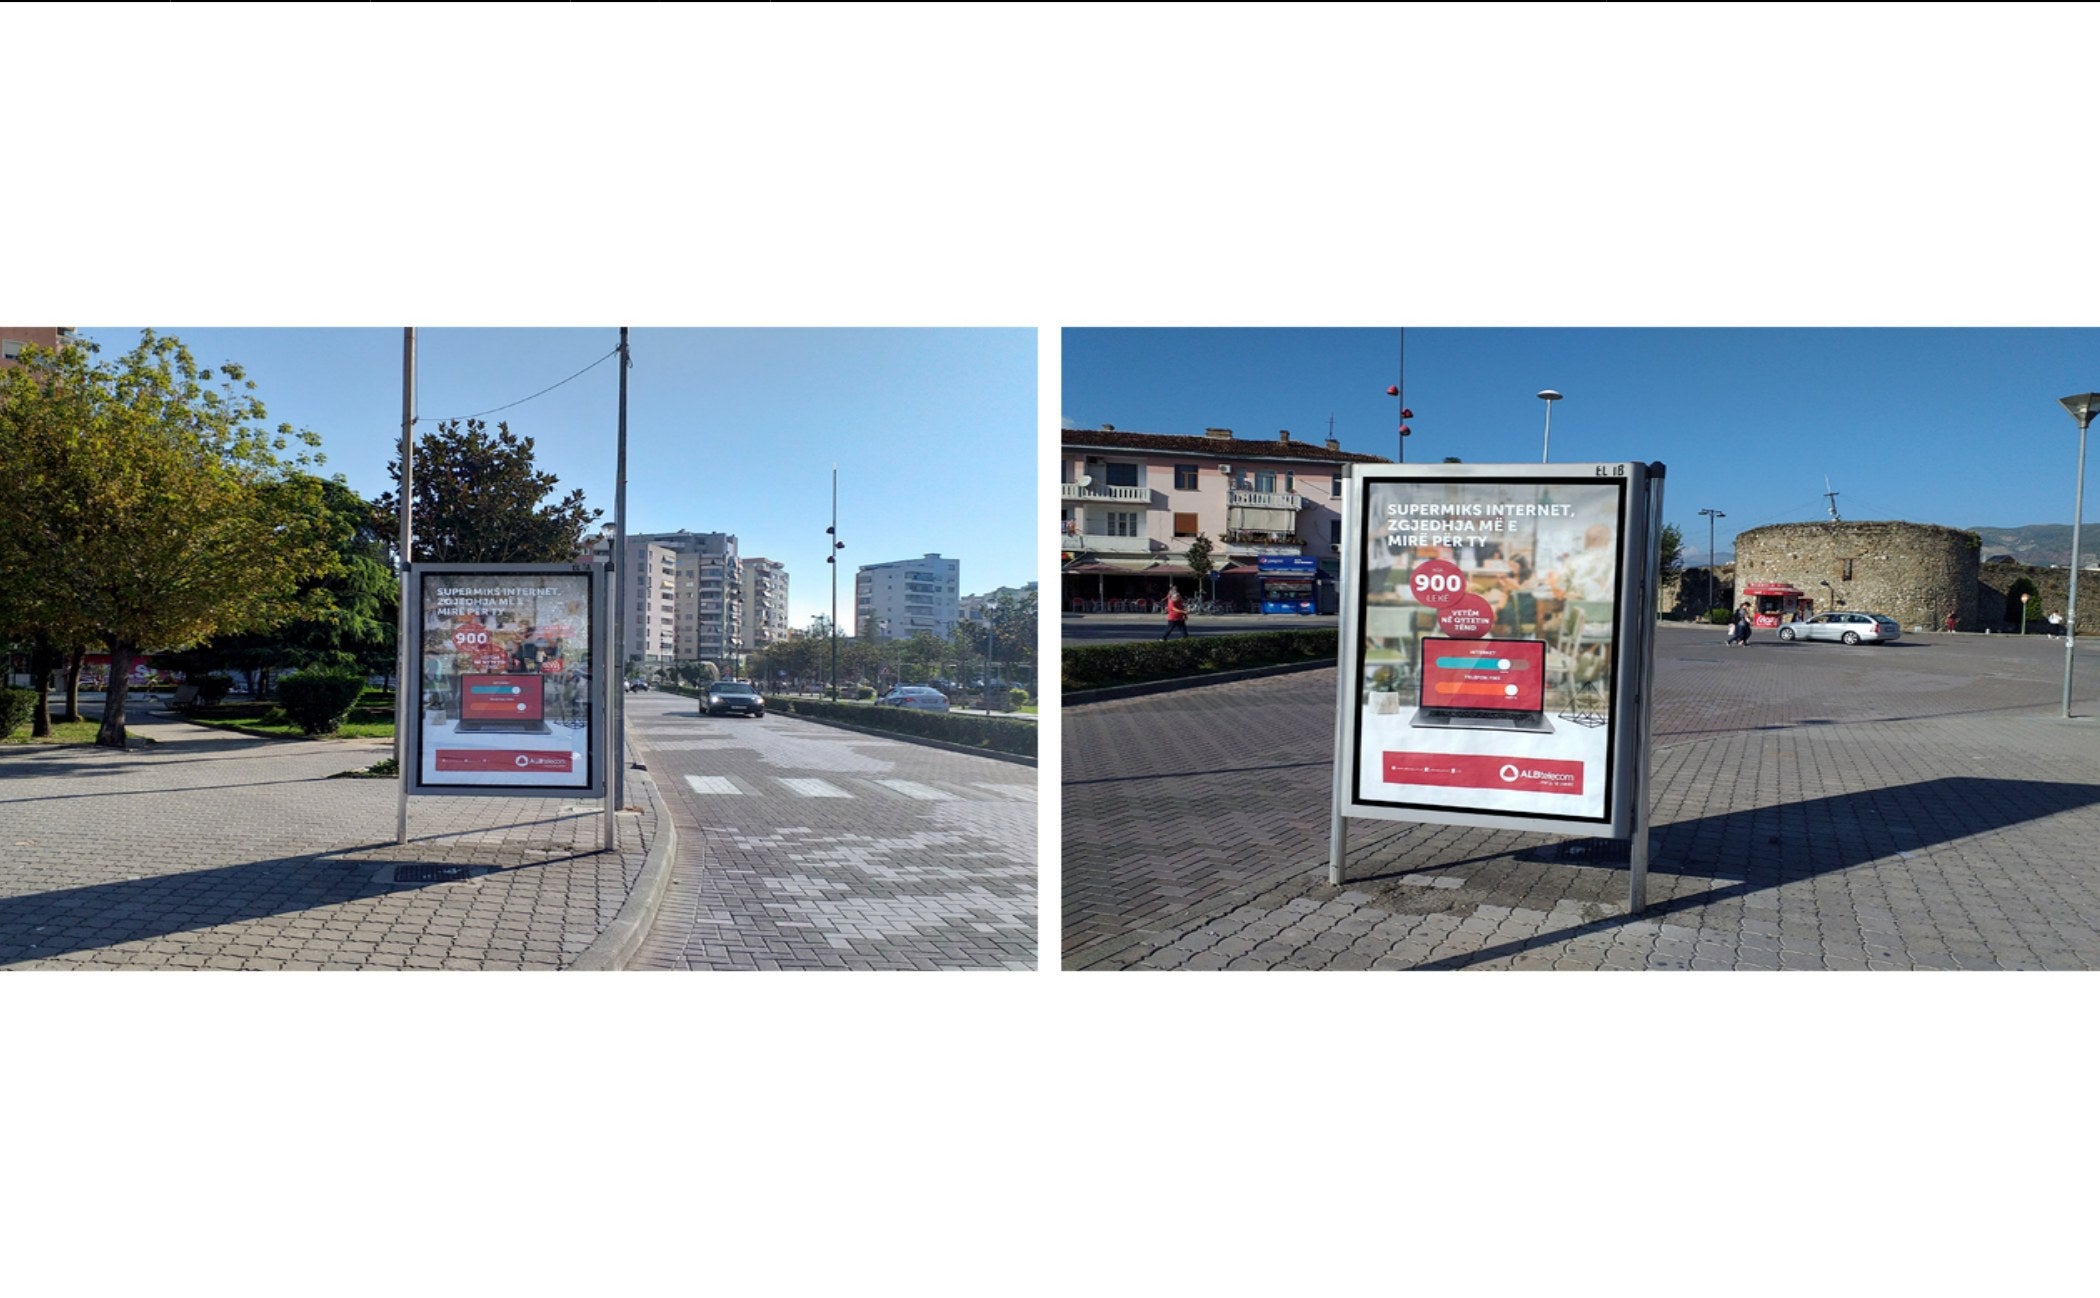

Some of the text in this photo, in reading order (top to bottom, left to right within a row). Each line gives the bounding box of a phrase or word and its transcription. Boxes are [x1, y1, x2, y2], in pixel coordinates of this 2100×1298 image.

[1595, 465, 1608, 476] EL
[1387, 503, 1576, 518] SUPERMIKS INTERNET,
[1387, 517, 1518, 532] ZGJEDHJA MË E
[1387, 533, 1488, 548] MIRË PËR TY
[1414, 573, 1462, 592] 900
[436, 587, 500, 596] SUPERMIKS
[455, 632, 487, 644] 900
